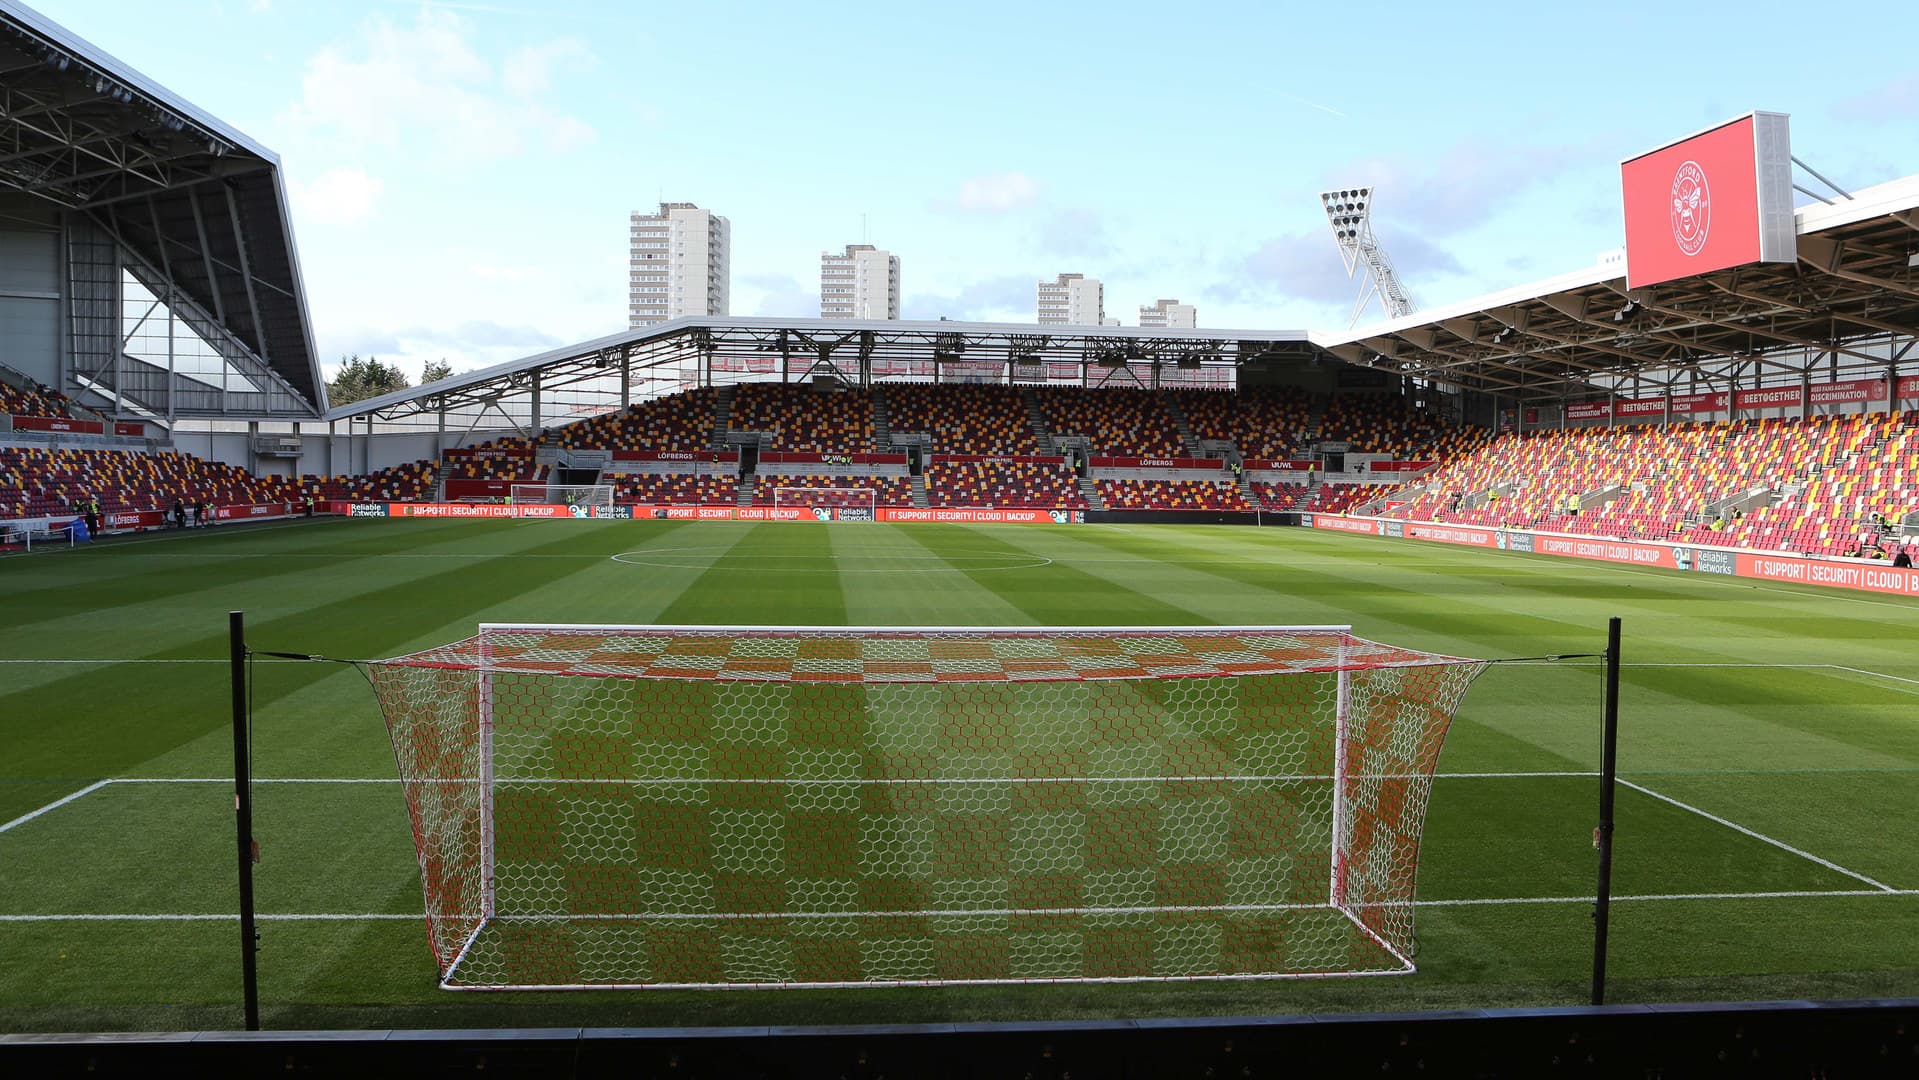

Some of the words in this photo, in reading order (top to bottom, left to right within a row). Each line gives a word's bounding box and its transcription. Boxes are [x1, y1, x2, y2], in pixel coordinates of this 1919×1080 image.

[1835, 383, 1855, 391] AGAINST
[1744, 390, 1801, 404] BEETOGETHER
[1811, 390, 1868, 401] DISCRIMINATION
[1623, 401, 1665, 413] BEETOGETHER
[657, 452, 693, 460] LÖFBERGS
[352, 503, 381, 511] Reliable
[414, 506, 446, 515] SUPPORT
[452, 507, 489, 515] SECURITY
[494, 507, 518, 515] CLOUD
[525, 507, 554, 515] BACKUP
[700, 509, 737, 518] SECURIT
[741, 509, 764, 518] CLOUD
[839, 508, 868, 517] Reliable
[890, 511, 897, 519] IT
[898, 511, 932, 520] SUPPORT
[937, 511, 972, 520] SECURITY
[977, 512, 1001, 521] CLOUD
[1006, 512, 1036, 521] BACKUP
[1549, 541, 1574, 553] SUPPORT
[1577, 543, 1606, 557] SECURITY
[1609, 546, 1630, 560] CLOUD
[1634, 548, 1660, 562] BACKUP
[1698, 550, 1728, 563] Reliable
[1697, 561, 1733, 575] Networks
[1754, 560, 1763, 574] IT
[1764, 560, 1805, 579] SUPPORT
[1812, 565, 1859, 585] SECURITY
[1867, 570, 1903, 589] CLOUD
